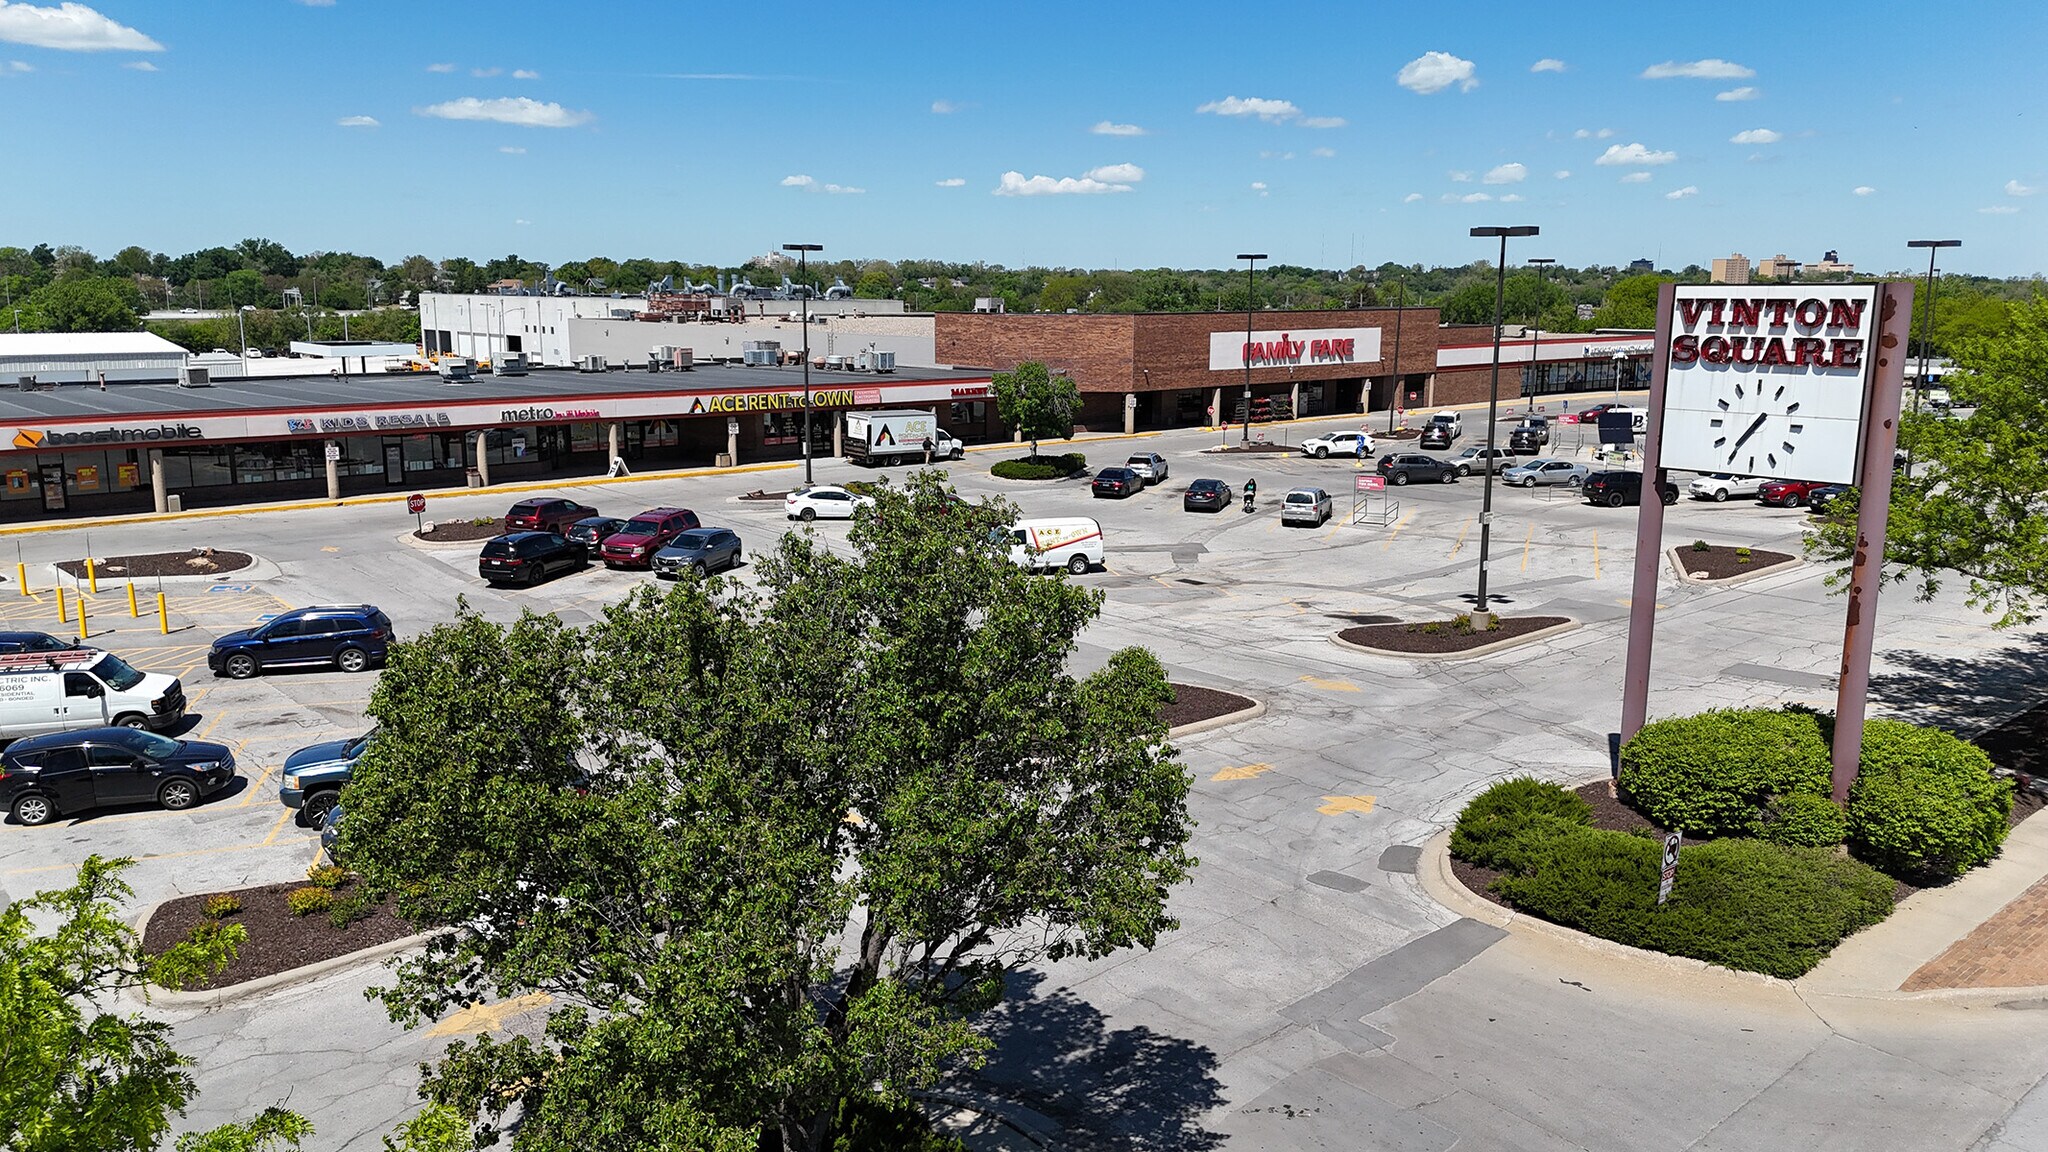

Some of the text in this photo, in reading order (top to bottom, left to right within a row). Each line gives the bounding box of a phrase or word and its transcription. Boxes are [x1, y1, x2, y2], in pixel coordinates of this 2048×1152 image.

[1676, 298, 1868, 330] VINTON
[1242, 333, 1355, 360] FAMILY FARE
[1671, 335, 1865, 368] SQUARE
[709, 396, 746, 413] ACE
[319, 416, 369, 429] KIDS
[375, 412, 450, 427] RESALE
[501, 406, 554, 421] metro
[905, 420, 928, 433] ACE
[409, 498, 425, 508] STOP
